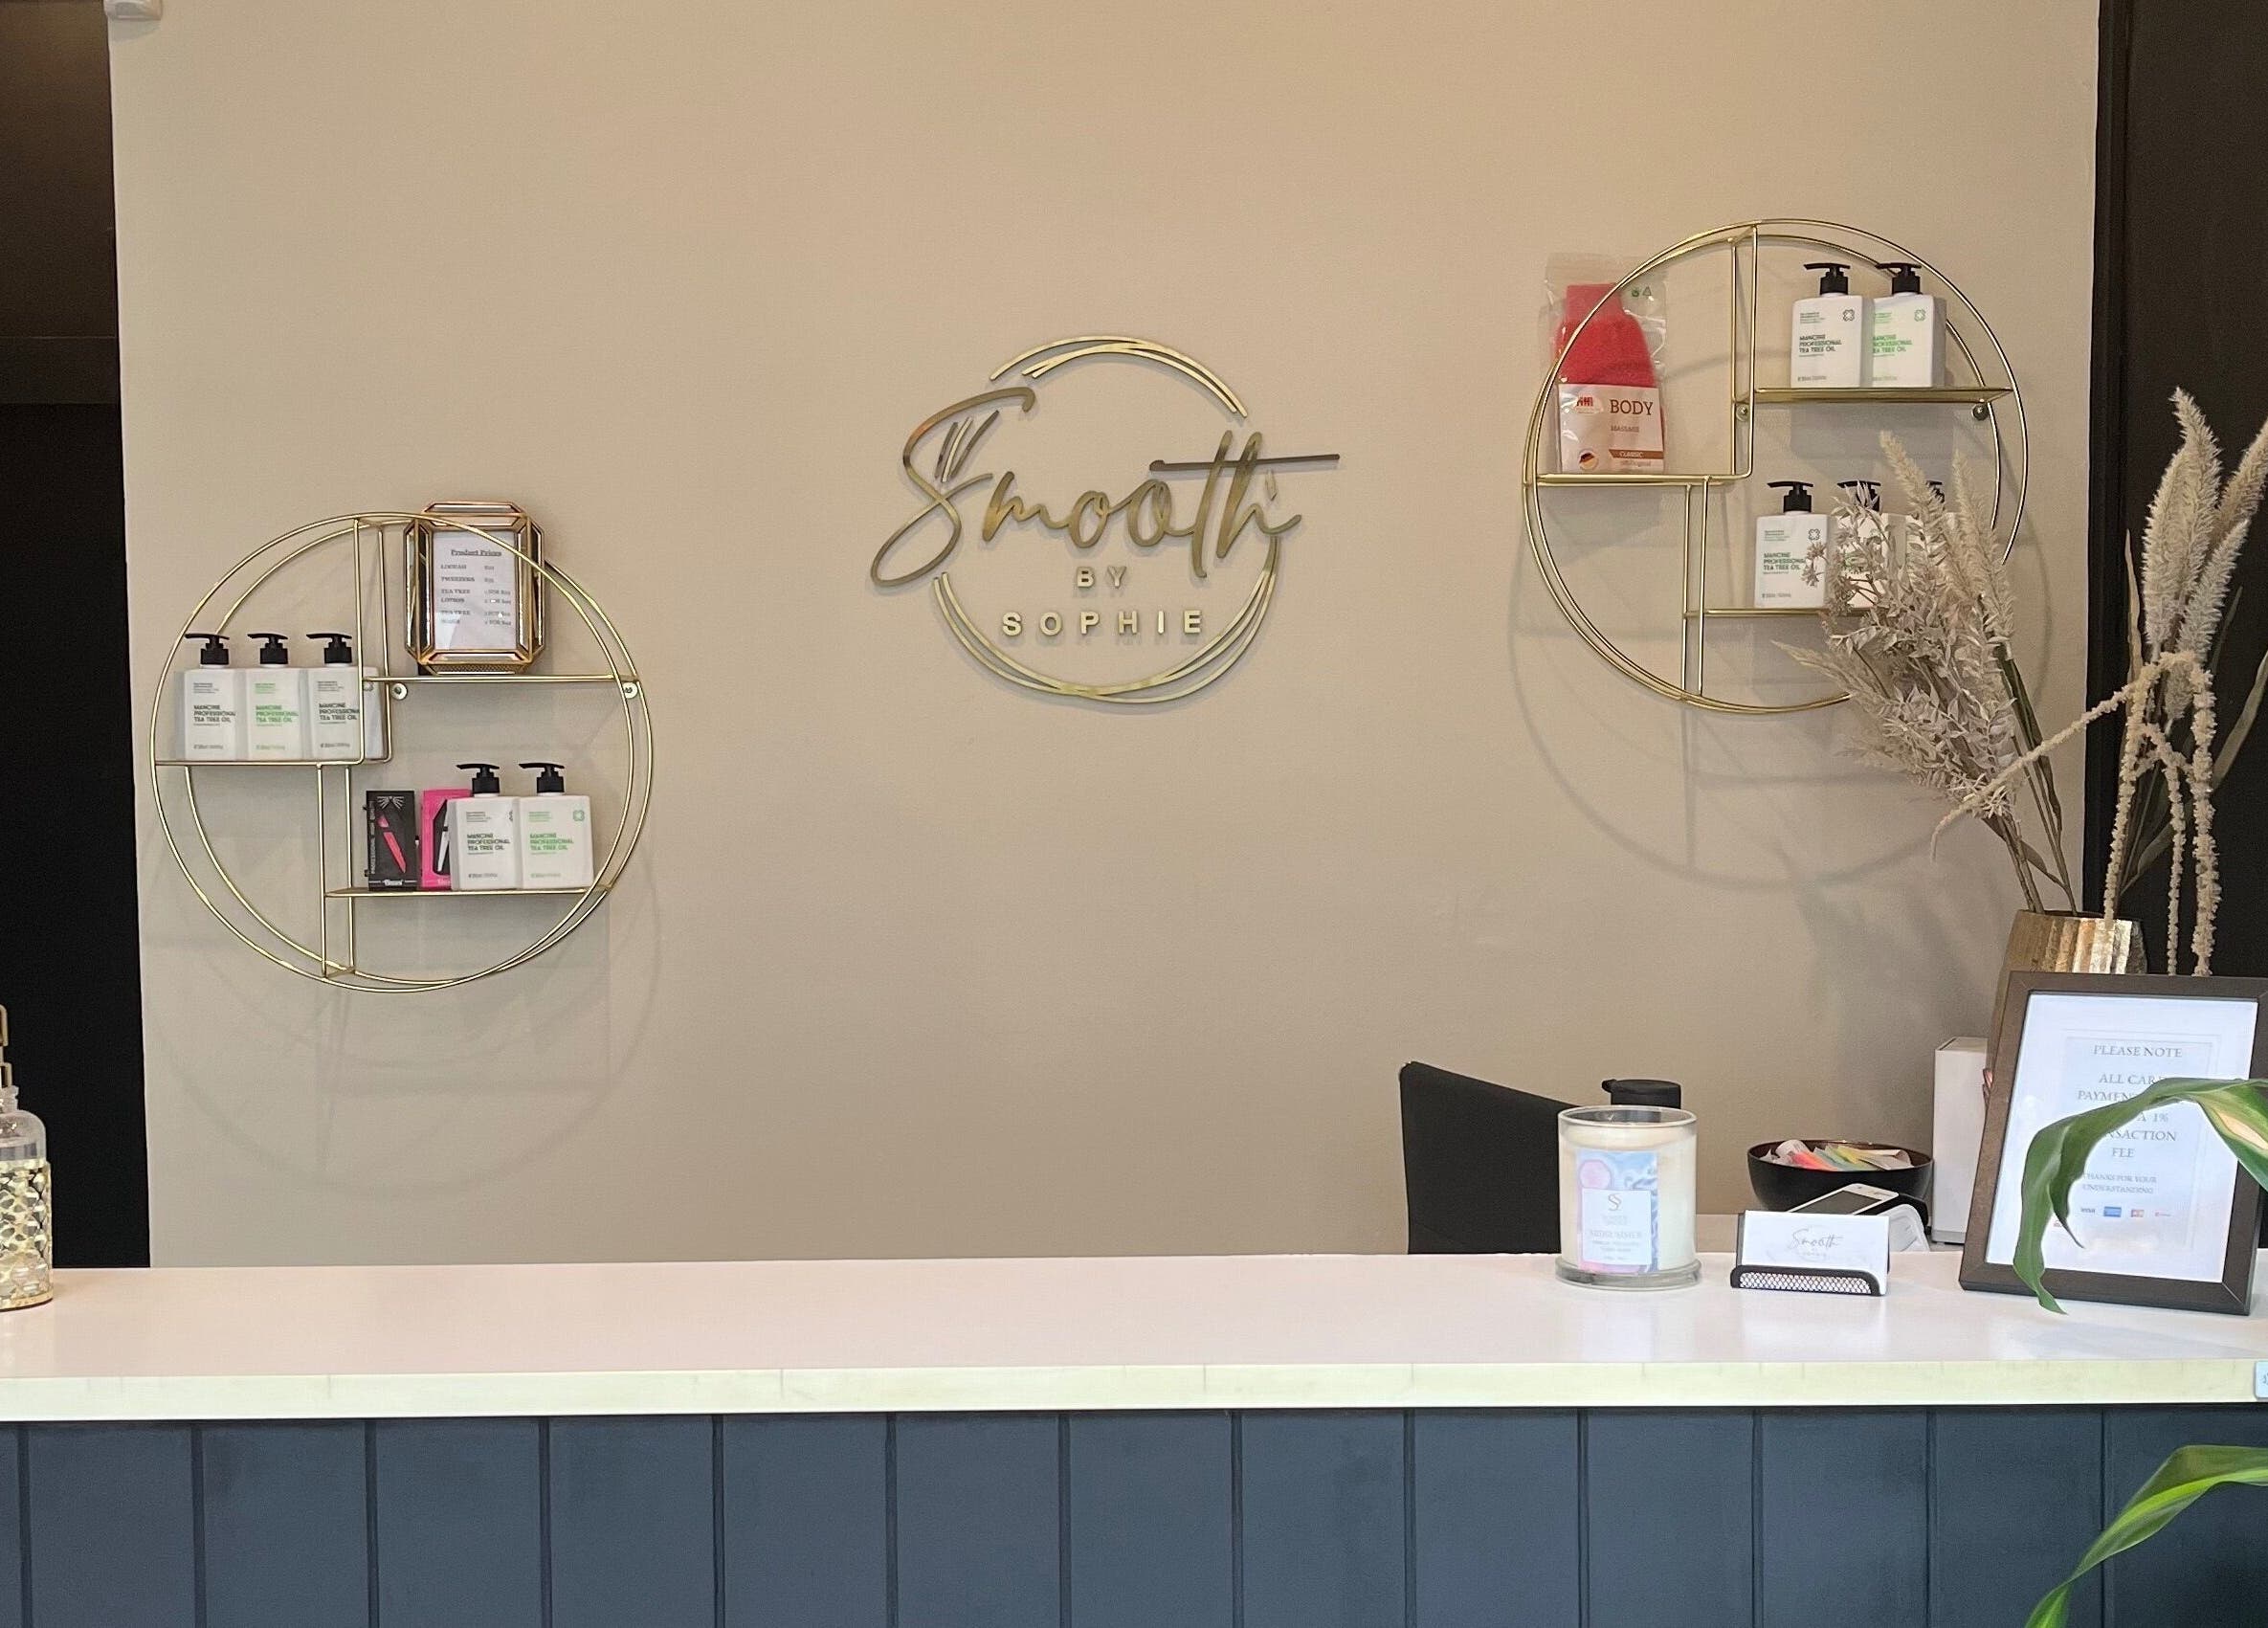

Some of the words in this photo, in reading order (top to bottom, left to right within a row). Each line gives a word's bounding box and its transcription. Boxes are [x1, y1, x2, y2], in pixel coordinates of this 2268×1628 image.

[1609, 398, 1654, 416] BODY
[870, 386, 1340, 586] Smooth
[1077, 567, 1126, 589] BY
[1002, 611, 1203, 637] SOPHIE
[2093, 1044, 2142, 1057] PLEASE
[2144, 1047, 2183, 1059] NOTE
[2098, 1073, 2124, 1084] ALL
[2111, 1147, 2135, 1158] FEE
[2134, 1175, 2157, 1184] YOUR
